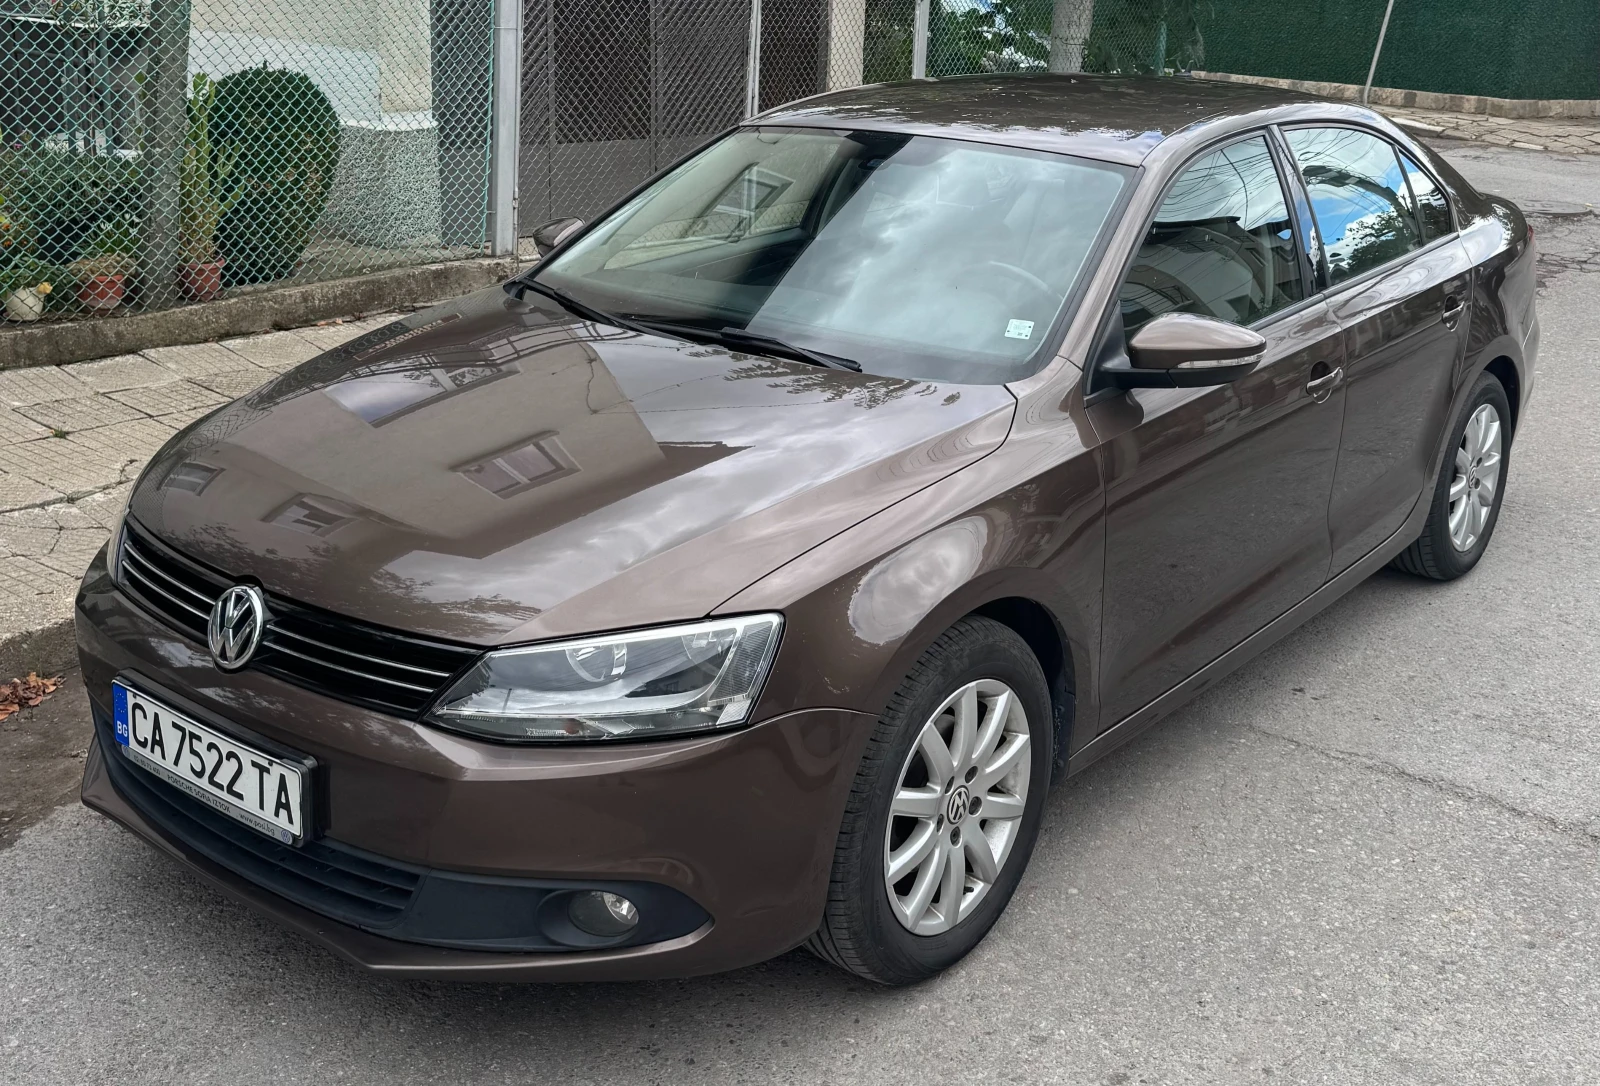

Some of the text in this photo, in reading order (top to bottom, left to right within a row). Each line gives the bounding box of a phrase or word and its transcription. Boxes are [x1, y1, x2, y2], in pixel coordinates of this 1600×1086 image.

[208, 586, 263, 669] VW
[117, 720, 128, 737] BG
[131, 702, 294, 825] CA 7522 TA
[167, 774, 194, 794] PORSCHE
[193, 788, 212, 804] SOFIA
[947, 785, 969, 825] VW
